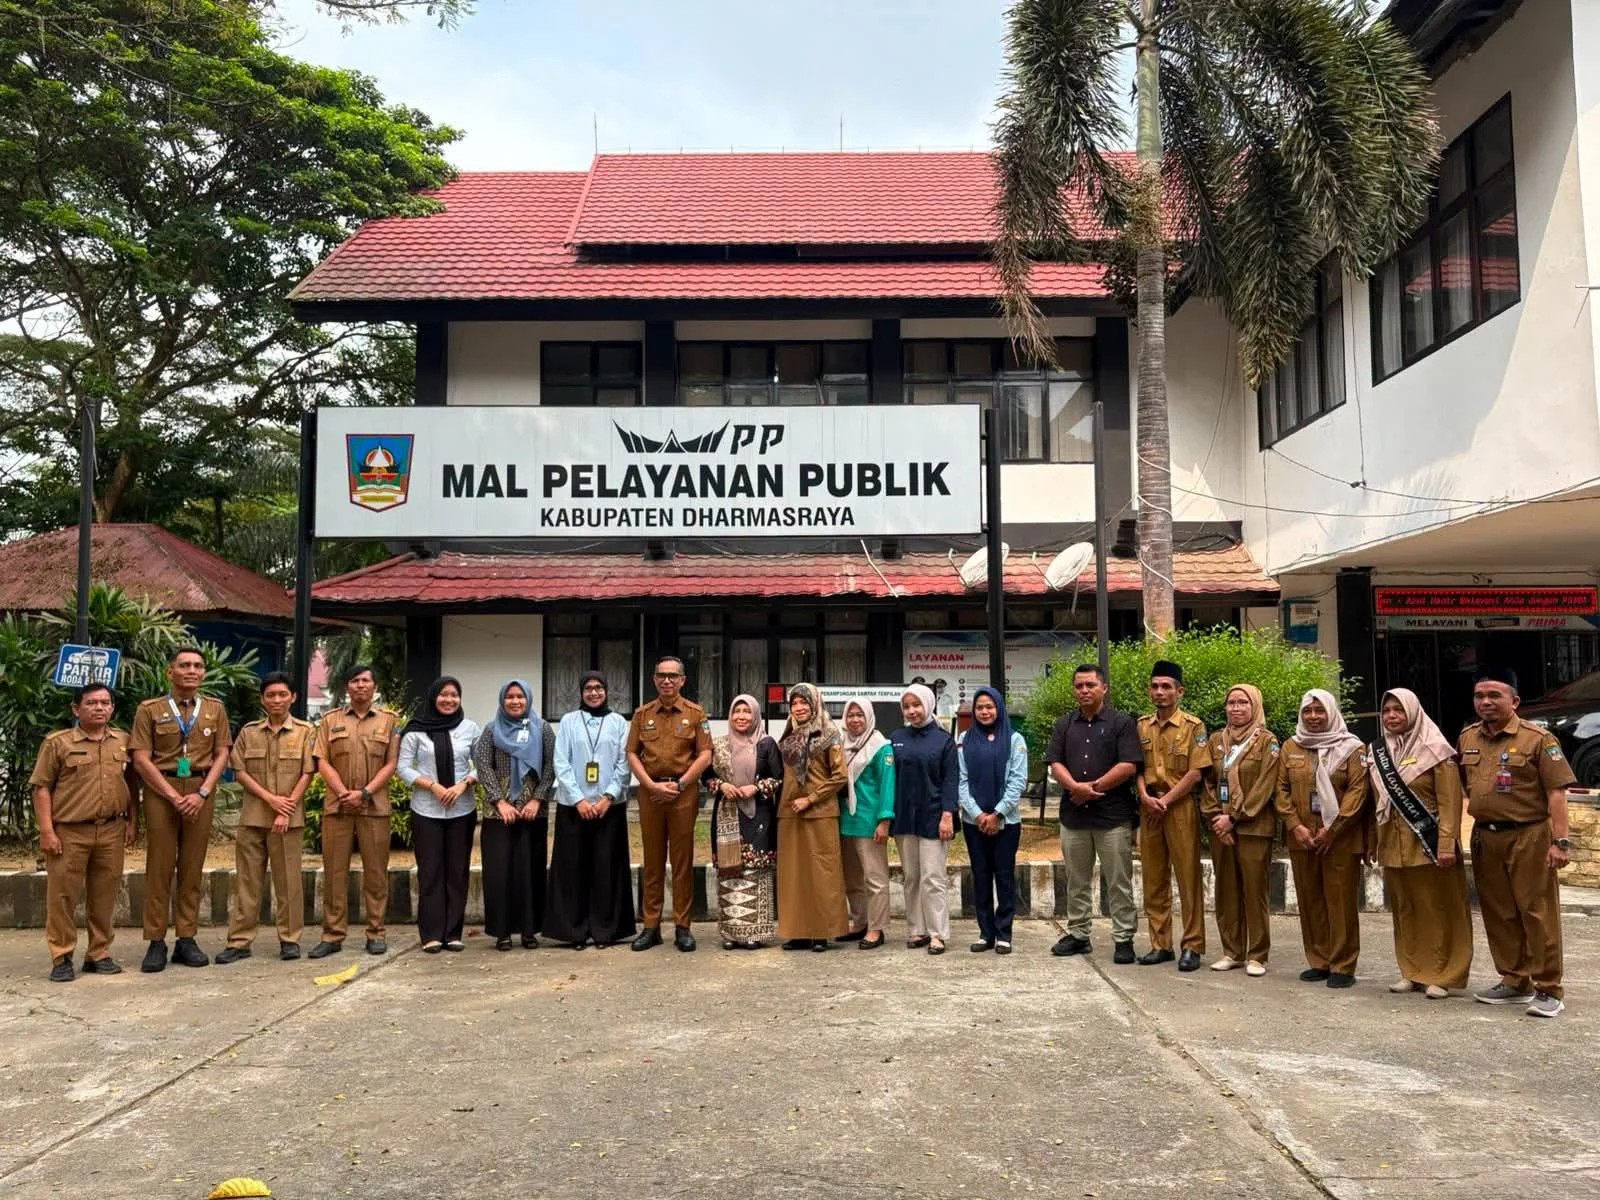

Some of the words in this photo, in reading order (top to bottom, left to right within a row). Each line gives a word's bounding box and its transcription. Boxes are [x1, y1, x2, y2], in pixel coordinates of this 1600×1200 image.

[442, 464, 528, 498] MAL
[543, 463, 784, 498] PELAYANAN
[799, 462, 951, 498] PUBLIK
[540, 507, 673, 528] KABUPATEN
[682, 506, 854, 527] DHARMASRAYA
[1406, 618, 1468, 627] MELAYANI
[1527, 617, 1568, 626] PRIMA
[909, 653, 965, 662] LAYANAN
[61, 675, 82, 685] RODA
